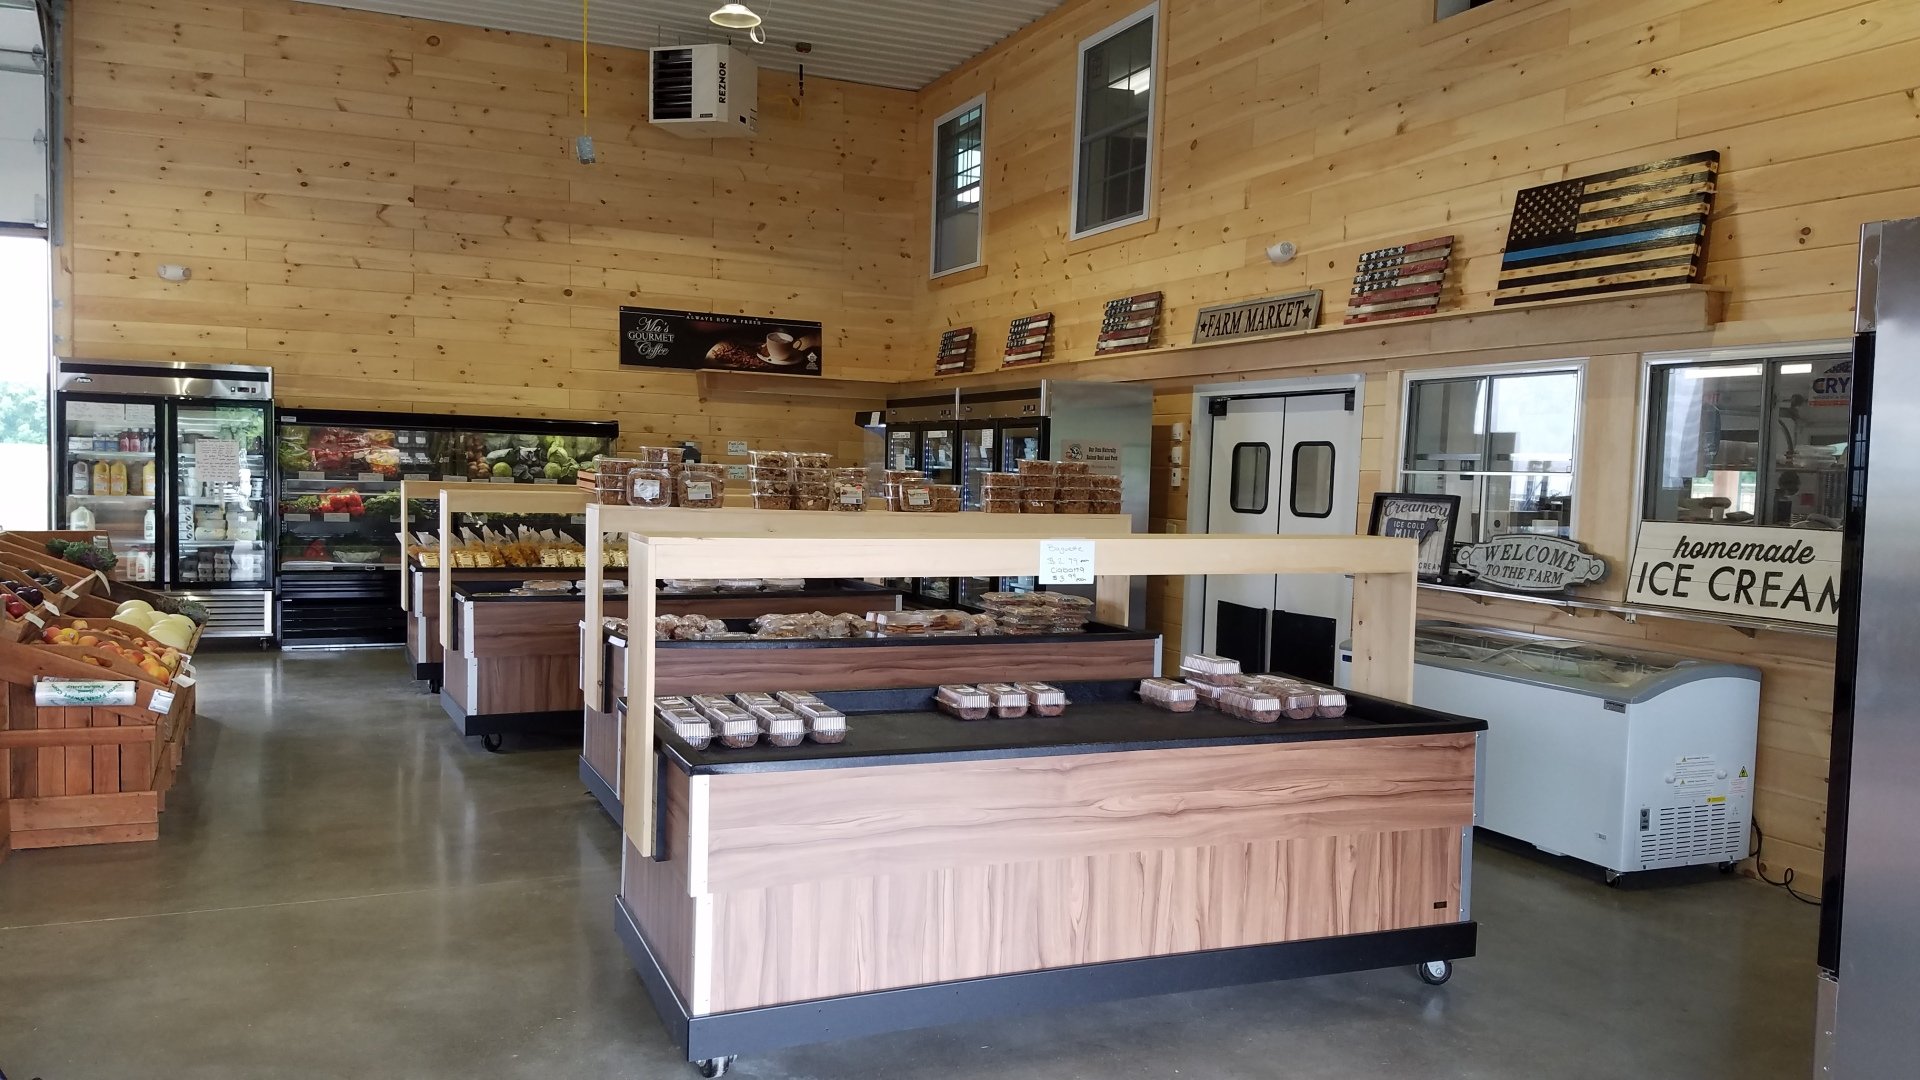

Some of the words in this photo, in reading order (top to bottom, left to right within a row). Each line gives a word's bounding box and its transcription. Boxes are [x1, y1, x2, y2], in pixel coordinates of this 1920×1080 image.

[719, 62, 727, 103] REZNOR
[636, 316, 669, 333] Ma's
[1205, 310, 1243, 337] FARM
[1244, 300, 1305, 333] MARKET
[627, 331, 674, 343] GOURMET
[635, 341, 669, 359] Coffee
[1384, 500, 1449, 524] Creamery
[1393, 520, 1405, 528] ICE
[1406, 521, 1425, 530] COLD
[1485, 543, 1581, 572] WELCOME
[1672, 535, 1816, 564] homemade
[1485, 563, 1501, 577] TO
[1501, 566, 1526, 579] THE
[1526, 569, 1564, 585] FARM
[1636, 561, 1695, 598] ICE
